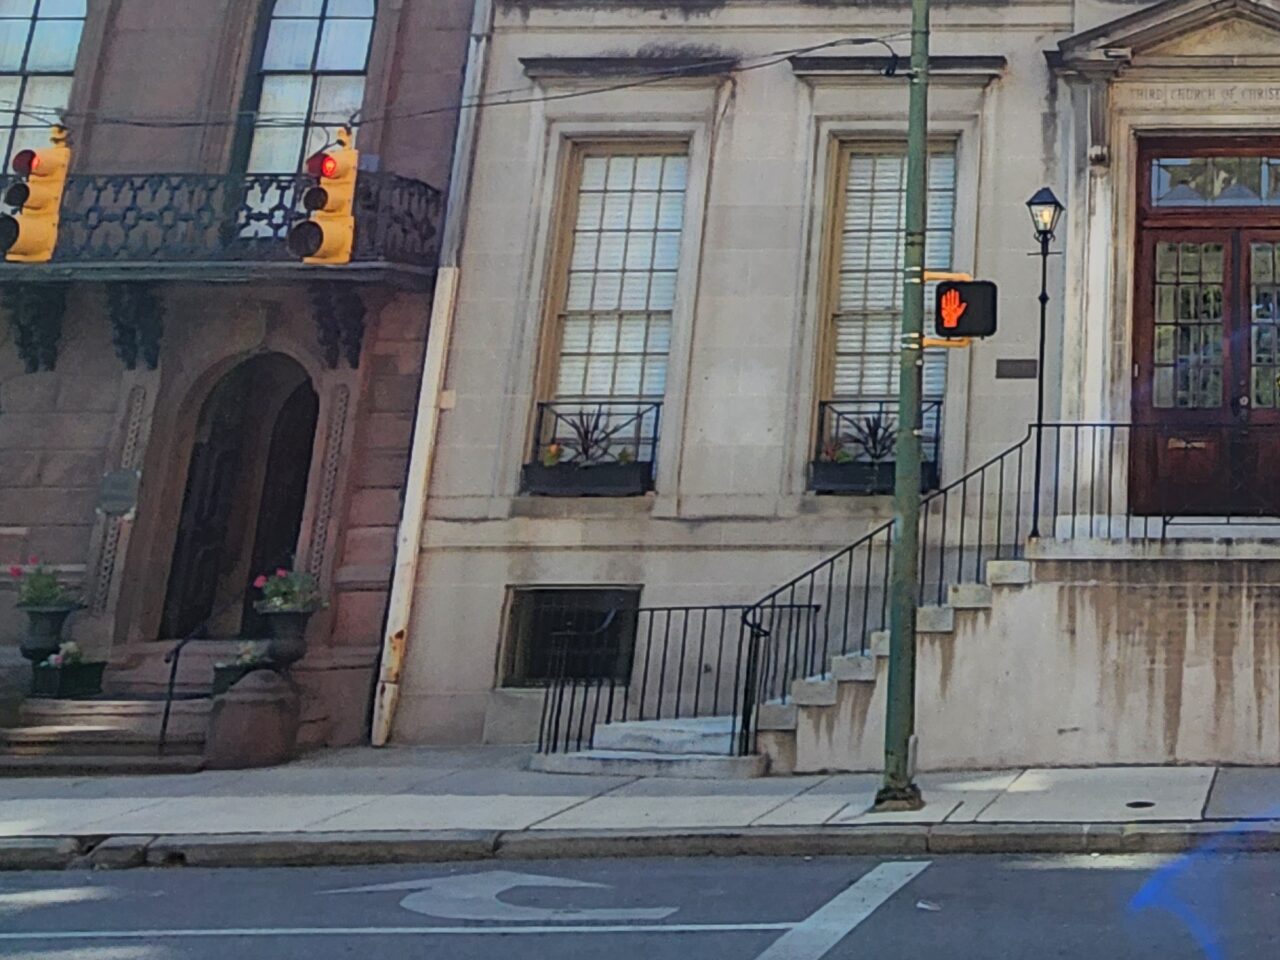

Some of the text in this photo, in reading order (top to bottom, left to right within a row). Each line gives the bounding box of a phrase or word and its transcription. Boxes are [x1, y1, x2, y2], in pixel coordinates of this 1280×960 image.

[1170, 87, 1216, 100] CHURCH
[1222, 87, 1235, 100] OF
[1241, 87, 1280, 100] CHRIST
